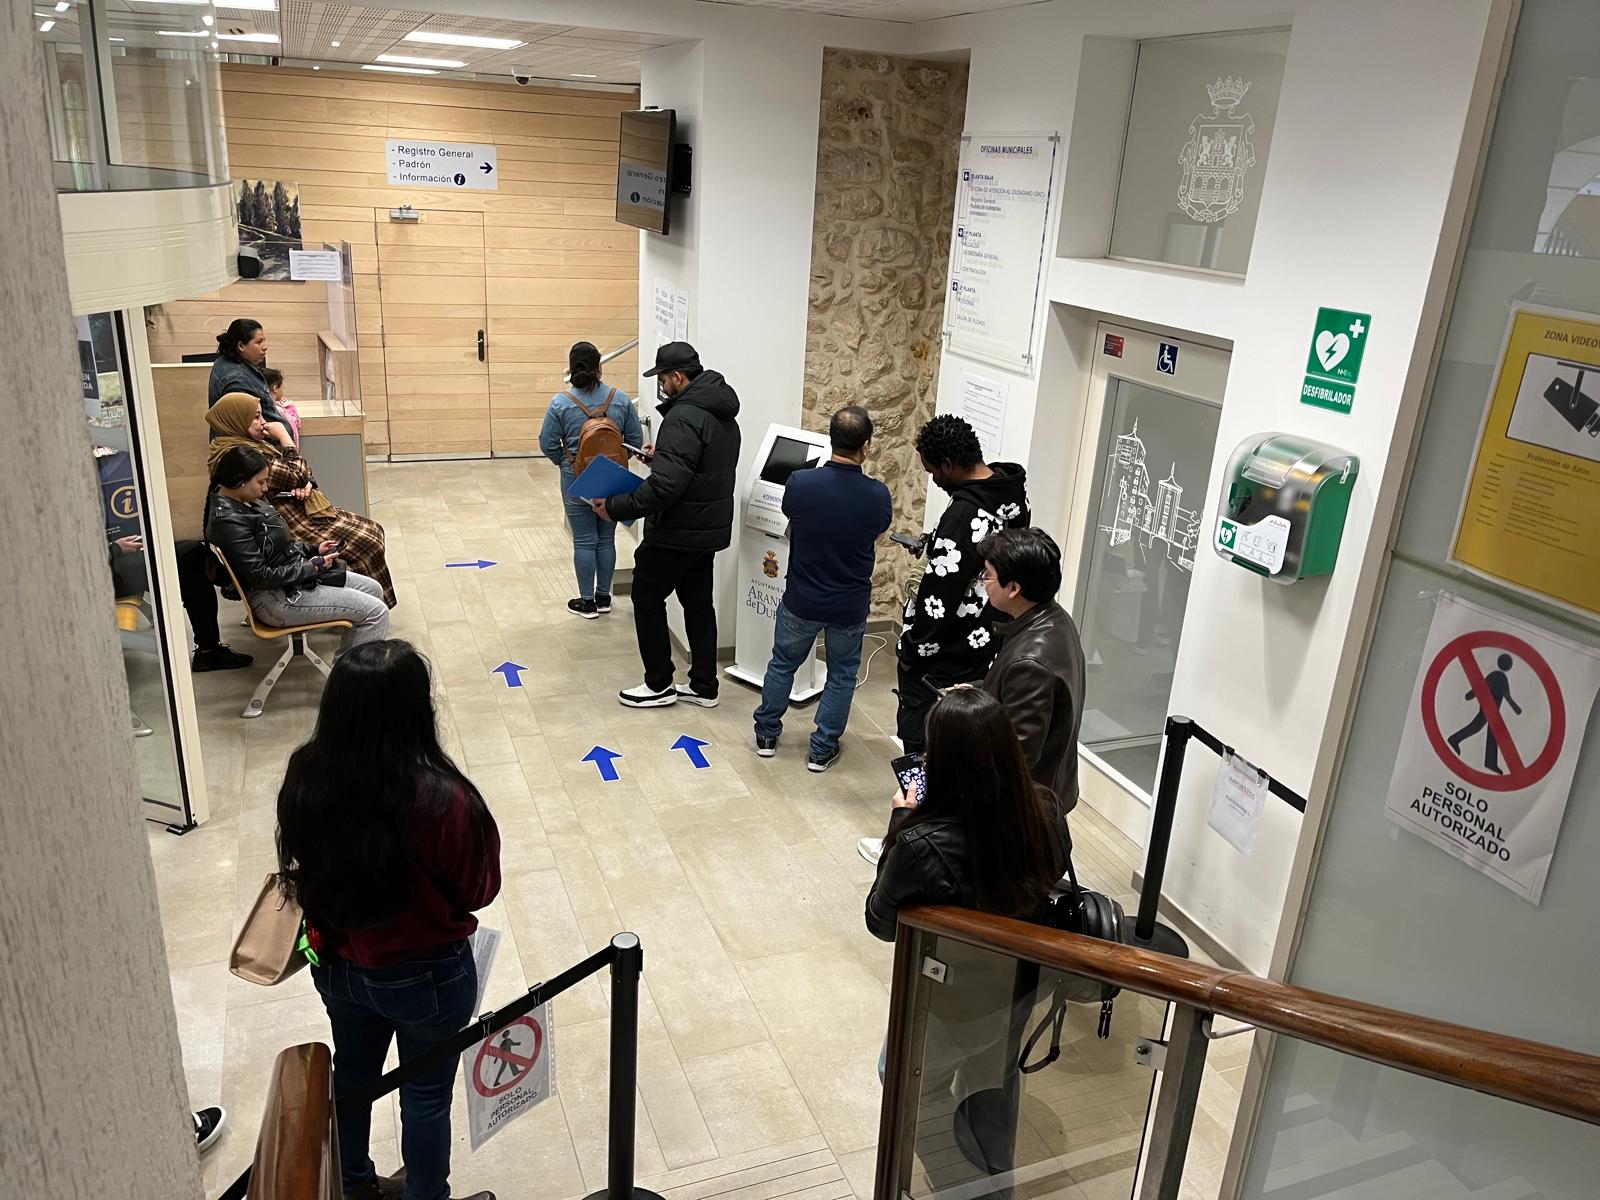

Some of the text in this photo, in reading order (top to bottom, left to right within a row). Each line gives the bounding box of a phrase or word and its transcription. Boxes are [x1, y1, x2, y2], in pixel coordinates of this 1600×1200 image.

[398, 145, 474, 159] Registro General
[980, 145, 1033, 155] OFICINAS MUNICIPALES
[398, 159, 431, 169] Padrón
[399, 172, 452, 183] Información
[1544, 329, 1568, 343] ZONA
[1302, 384, 1352, 406] DESFIBRILADOR
[750, 578, 784, 592] AYUNTAMIEN
[748, 586, 781, 607] ARAN
[1444, 781, 1488, 813] SOLO
[1422, 786, 1506, 843] PERSONAL
[1410, 798, 1511, 862] AUTORIZADO
[490, 1088, 533, 1120] PERSONAL
[498, 1086, 522, 1105] SOLO
[487, 1091, 538, 1130] AUTORIZADO
